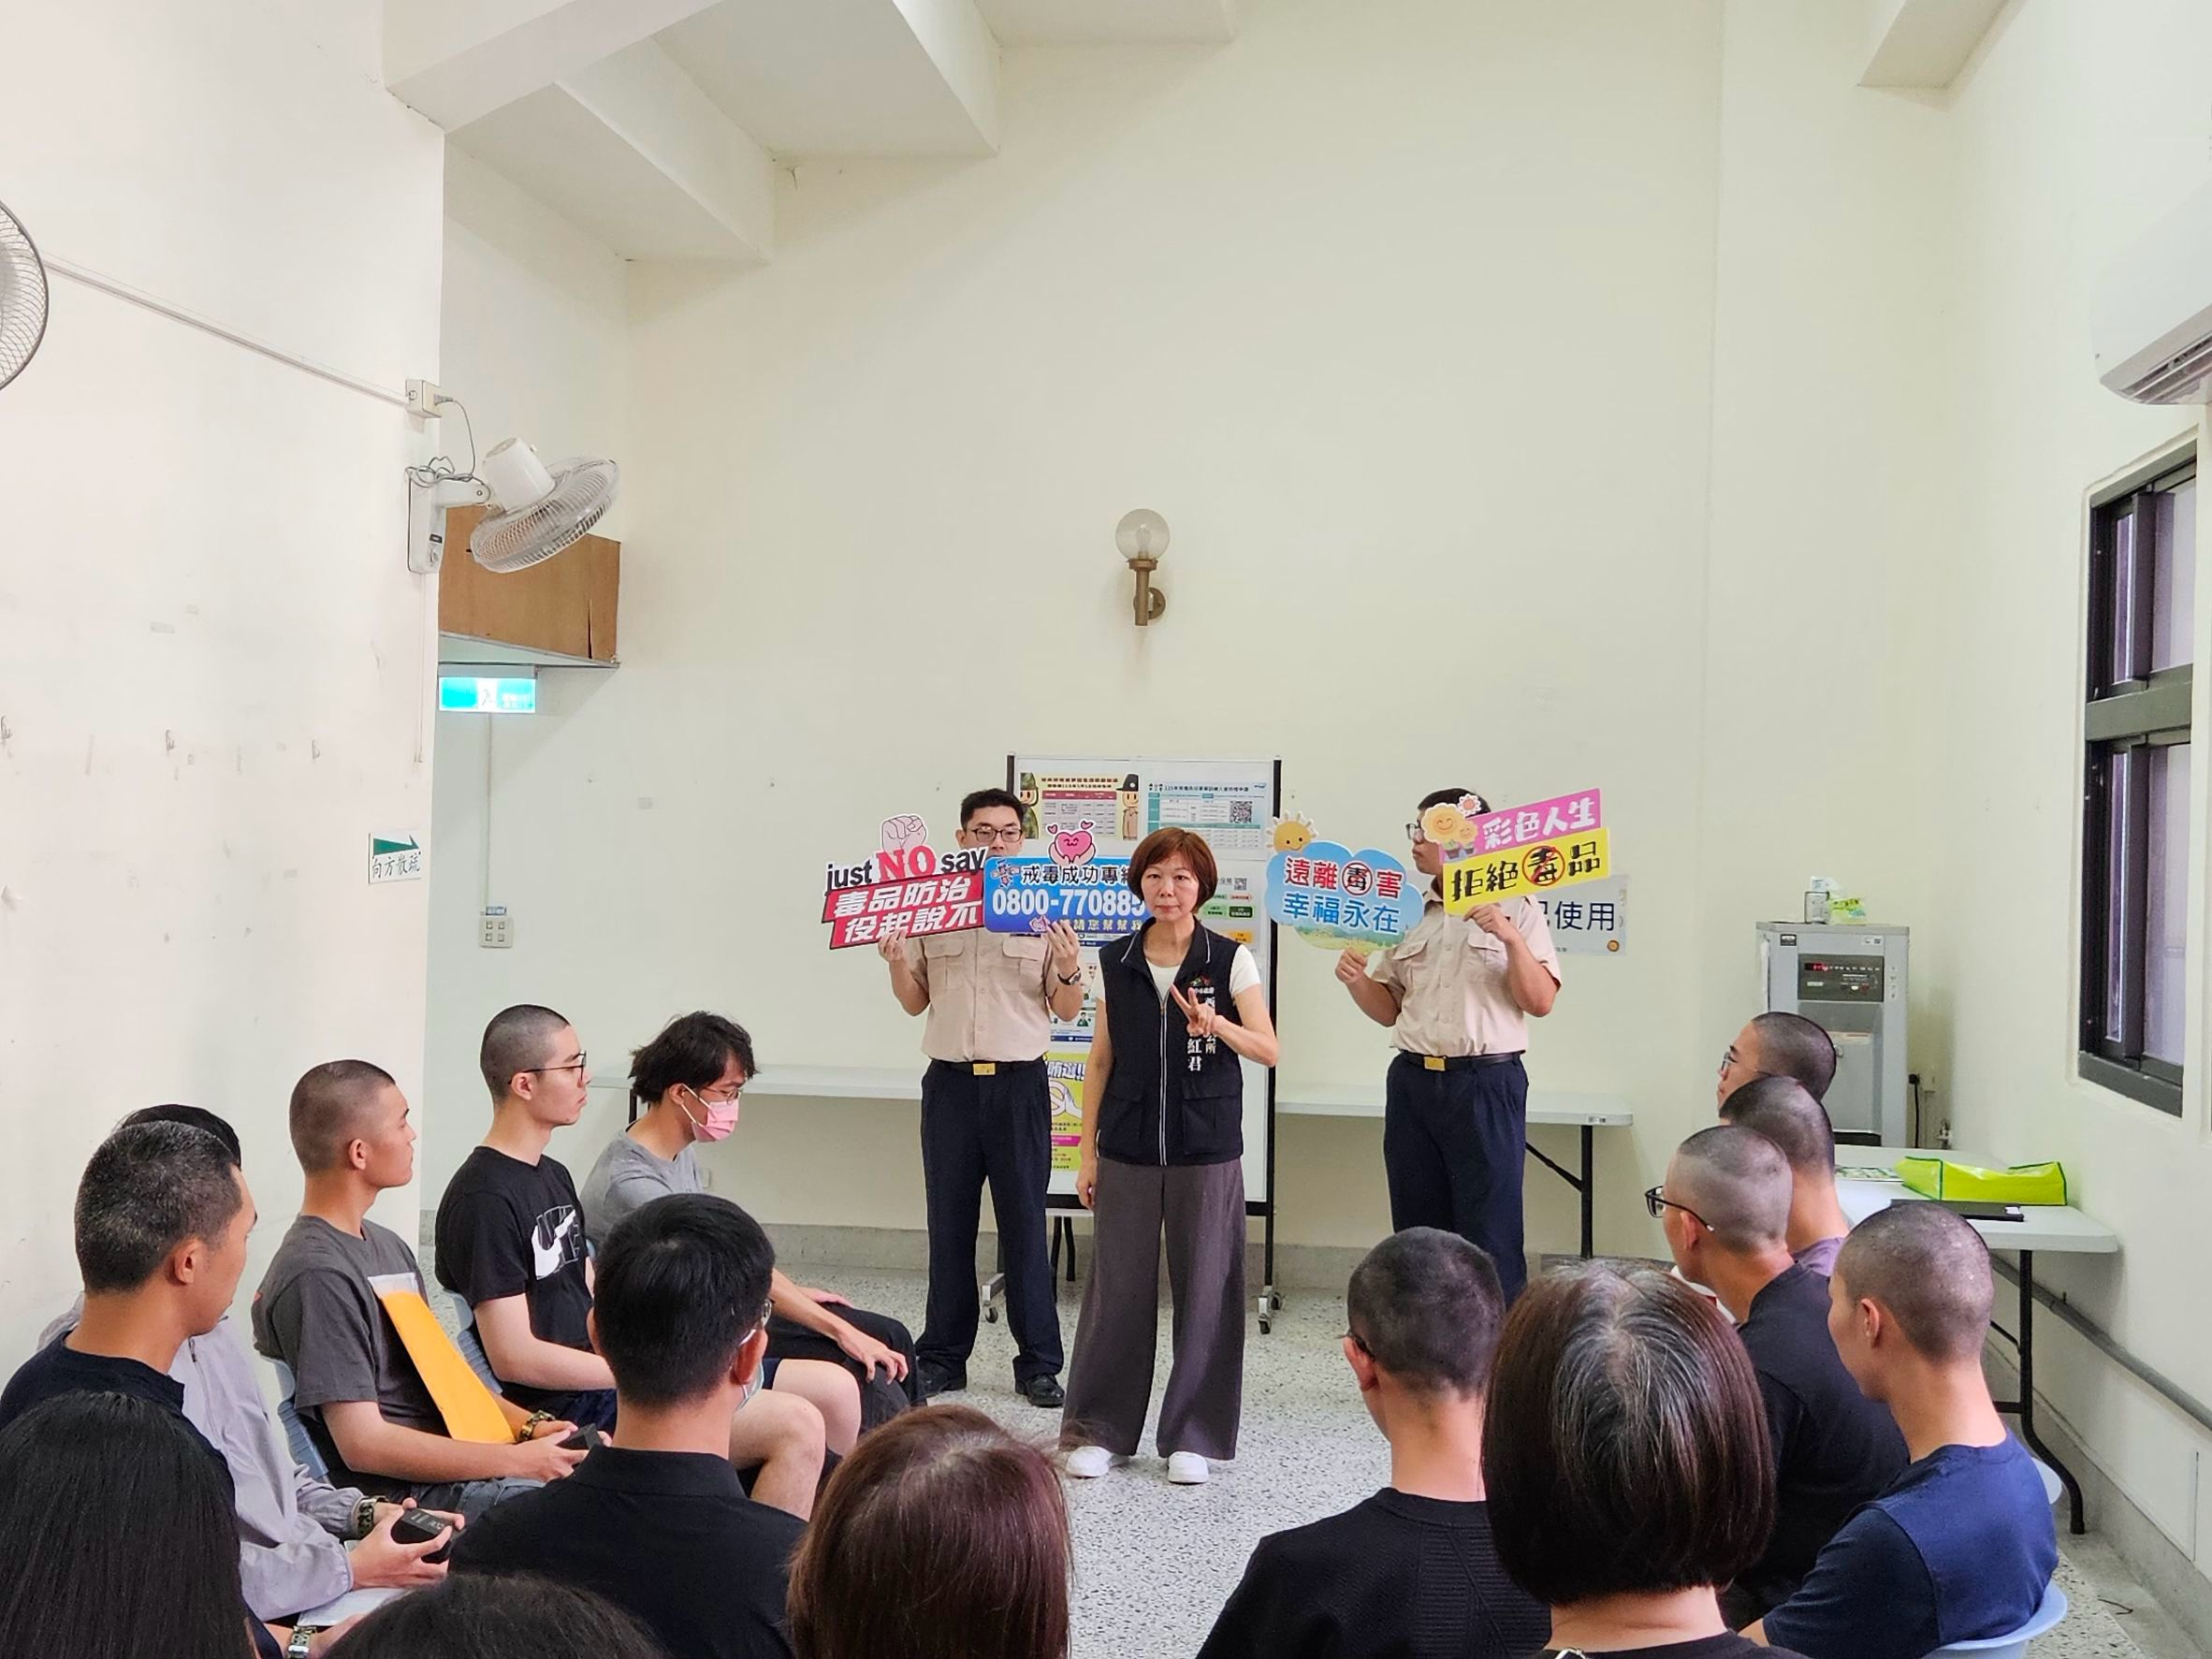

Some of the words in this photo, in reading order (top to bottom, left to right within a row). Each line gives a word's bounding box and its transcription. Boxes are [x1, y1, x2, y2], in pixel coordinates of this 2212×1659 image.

[1482, 797, 1596, 850] 彩色人生
[824, 859, 872, 895] just
[876, 846, 936, 882] NO
[940, 849, 986, 875] say
[1285, 857, 1403, 899] 遠離毒害
[1451, 841, 1601, 902] 拒絕毒品
[834, 876, 971, 918] 毒品防治
[1283, 893, 1400, 934] 幸福永在
